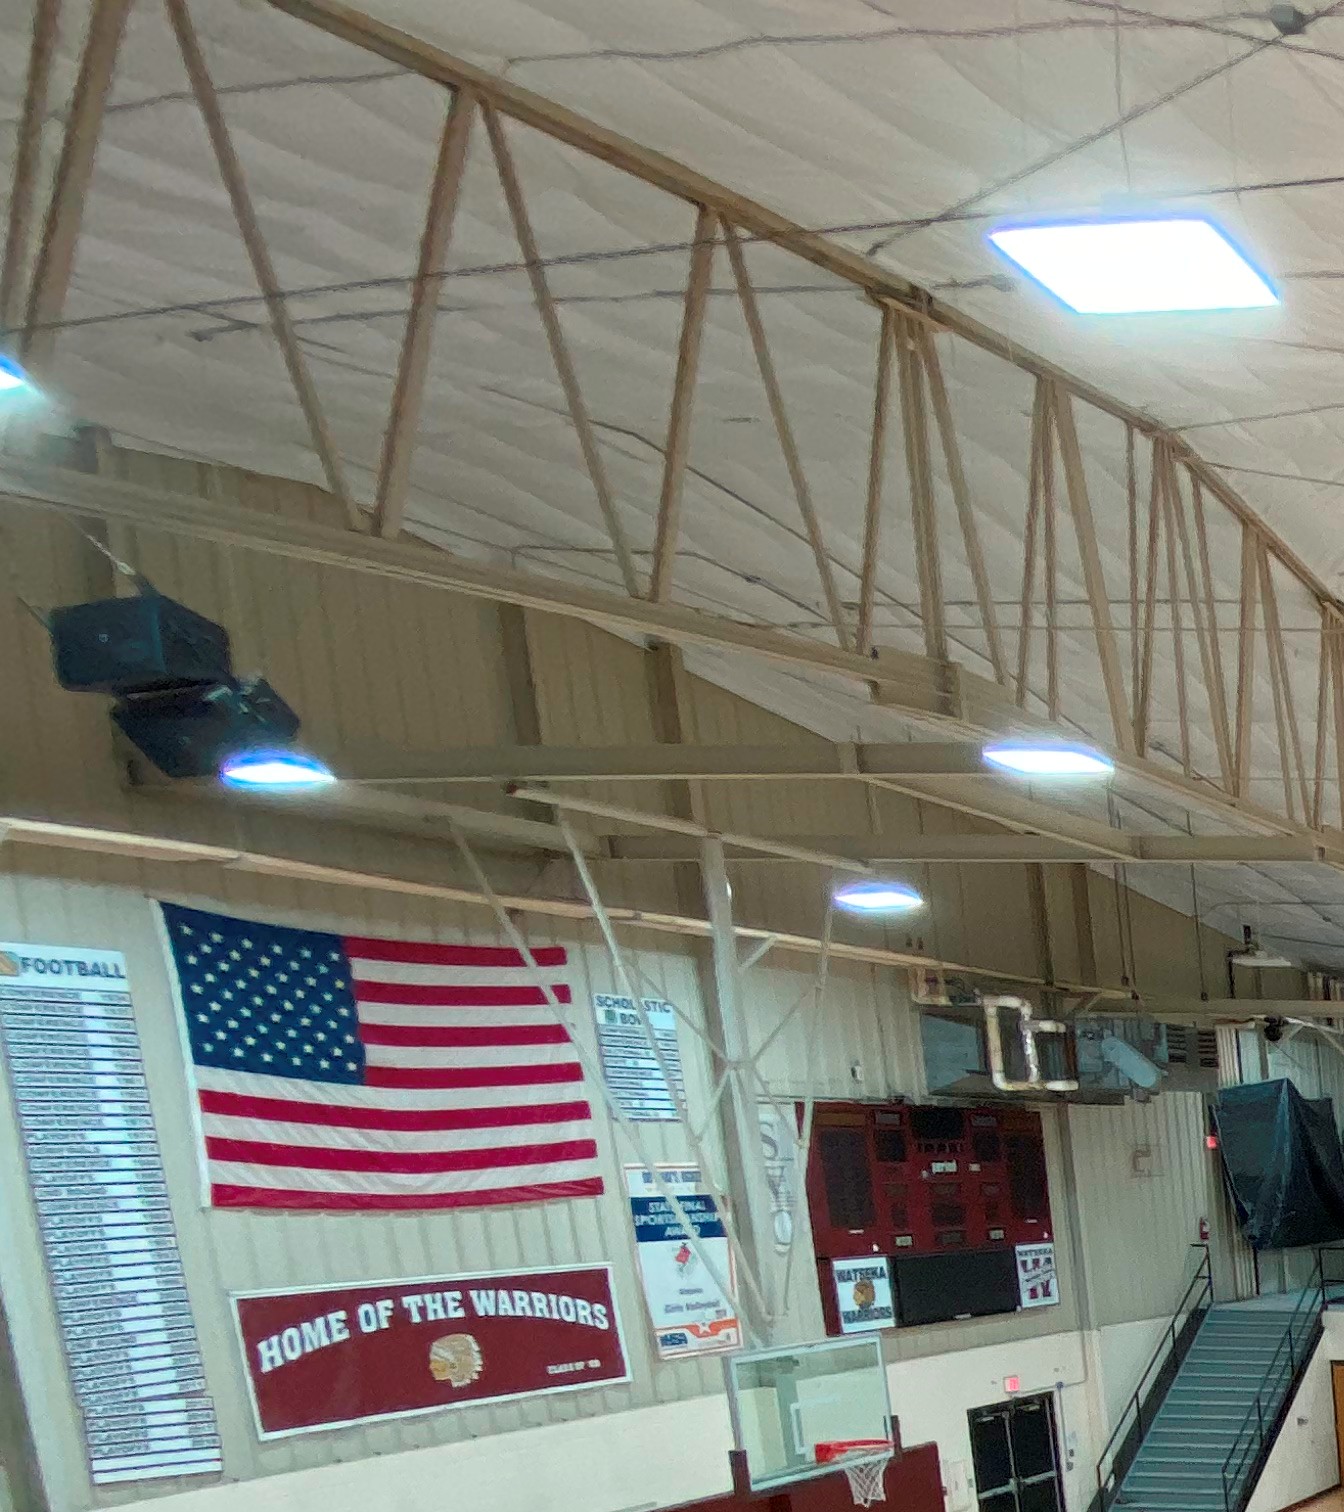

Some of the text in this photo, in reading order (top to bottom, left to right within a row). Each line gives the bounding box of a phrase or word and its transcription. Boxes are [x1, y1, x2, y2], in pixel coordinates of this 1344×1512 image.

[20, 956, 127, 980] FOOTBALL
[595, 995, 671, 1014] SCHOLSTIC
[835, 1266, 887, 1282] WATSEKA
[256, 1288, 611, 1374] HOME OF THE WARRIORS
